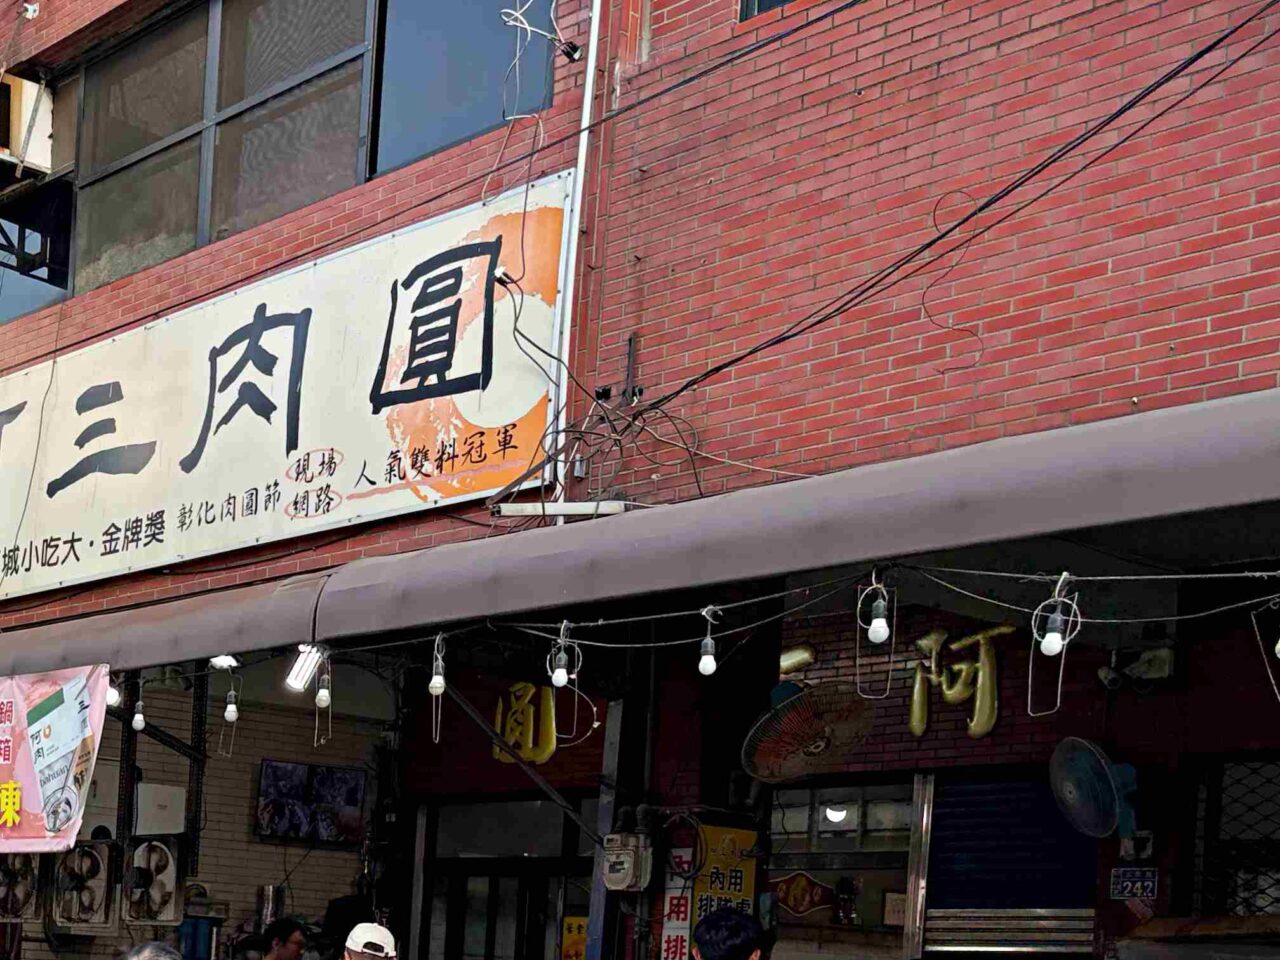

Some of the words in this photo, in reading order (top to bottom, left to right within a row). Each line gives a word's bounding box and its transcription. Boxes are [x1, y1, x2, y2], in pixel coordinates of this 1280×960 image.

[294, 448, 337, 483] 現場
[354, 424, 519, 488] 人氣雙料冠軍
[176, 481, 281, 532] 彰化肉圓節
[292, 484, 334, 520] 網路
[709, 865, 744, 893] 內用
